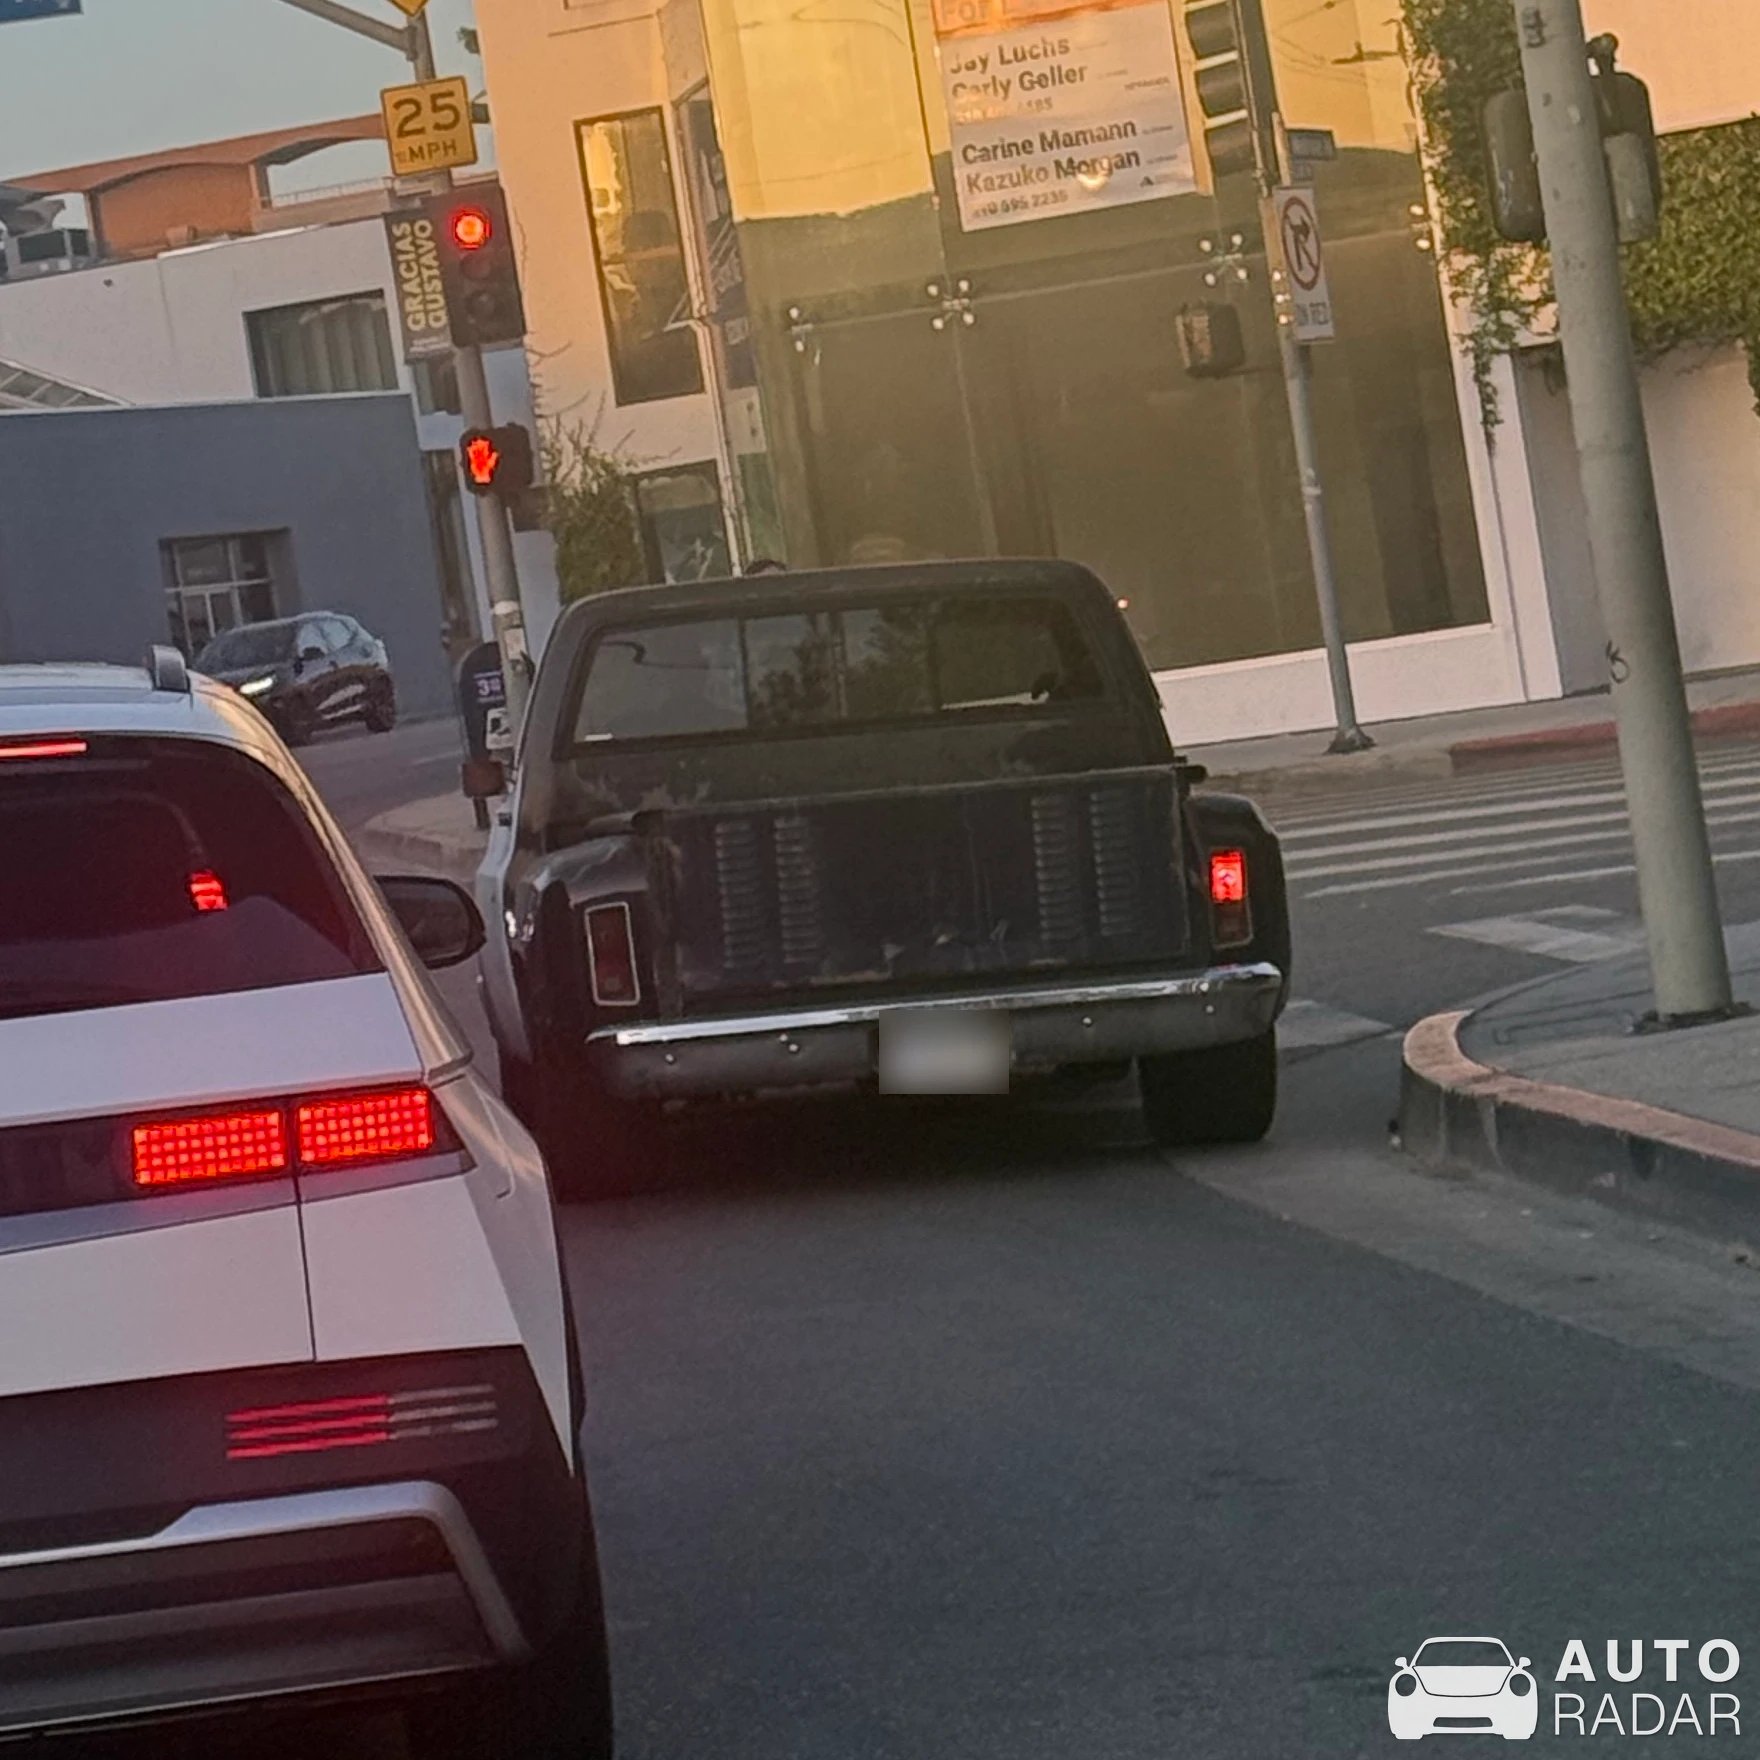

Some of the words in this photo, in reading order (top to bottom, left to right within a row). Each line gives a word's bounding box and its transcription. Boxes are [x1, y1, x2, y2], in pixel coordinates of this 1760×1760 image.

[950, 52, 989, 75] Jay
[998, 36, 1071, 66] Luchs
[951, 74, 1011, 102] Carly
[1018, 65, 1088, 92] Geller
[393, 90, 460, 138] 25
[408, 139, 457, 163] MPH
[962, 137, 1034, 164] Carine
[1039, 120, 1138, 152] Mamann
[966, 163, 1050, 195] Kazuko
[1053, 150, 1140, 180] Morgan
[392, 221, 426, 331] GRACIAS
[413, 219, 447, 328] GUSTAVO
